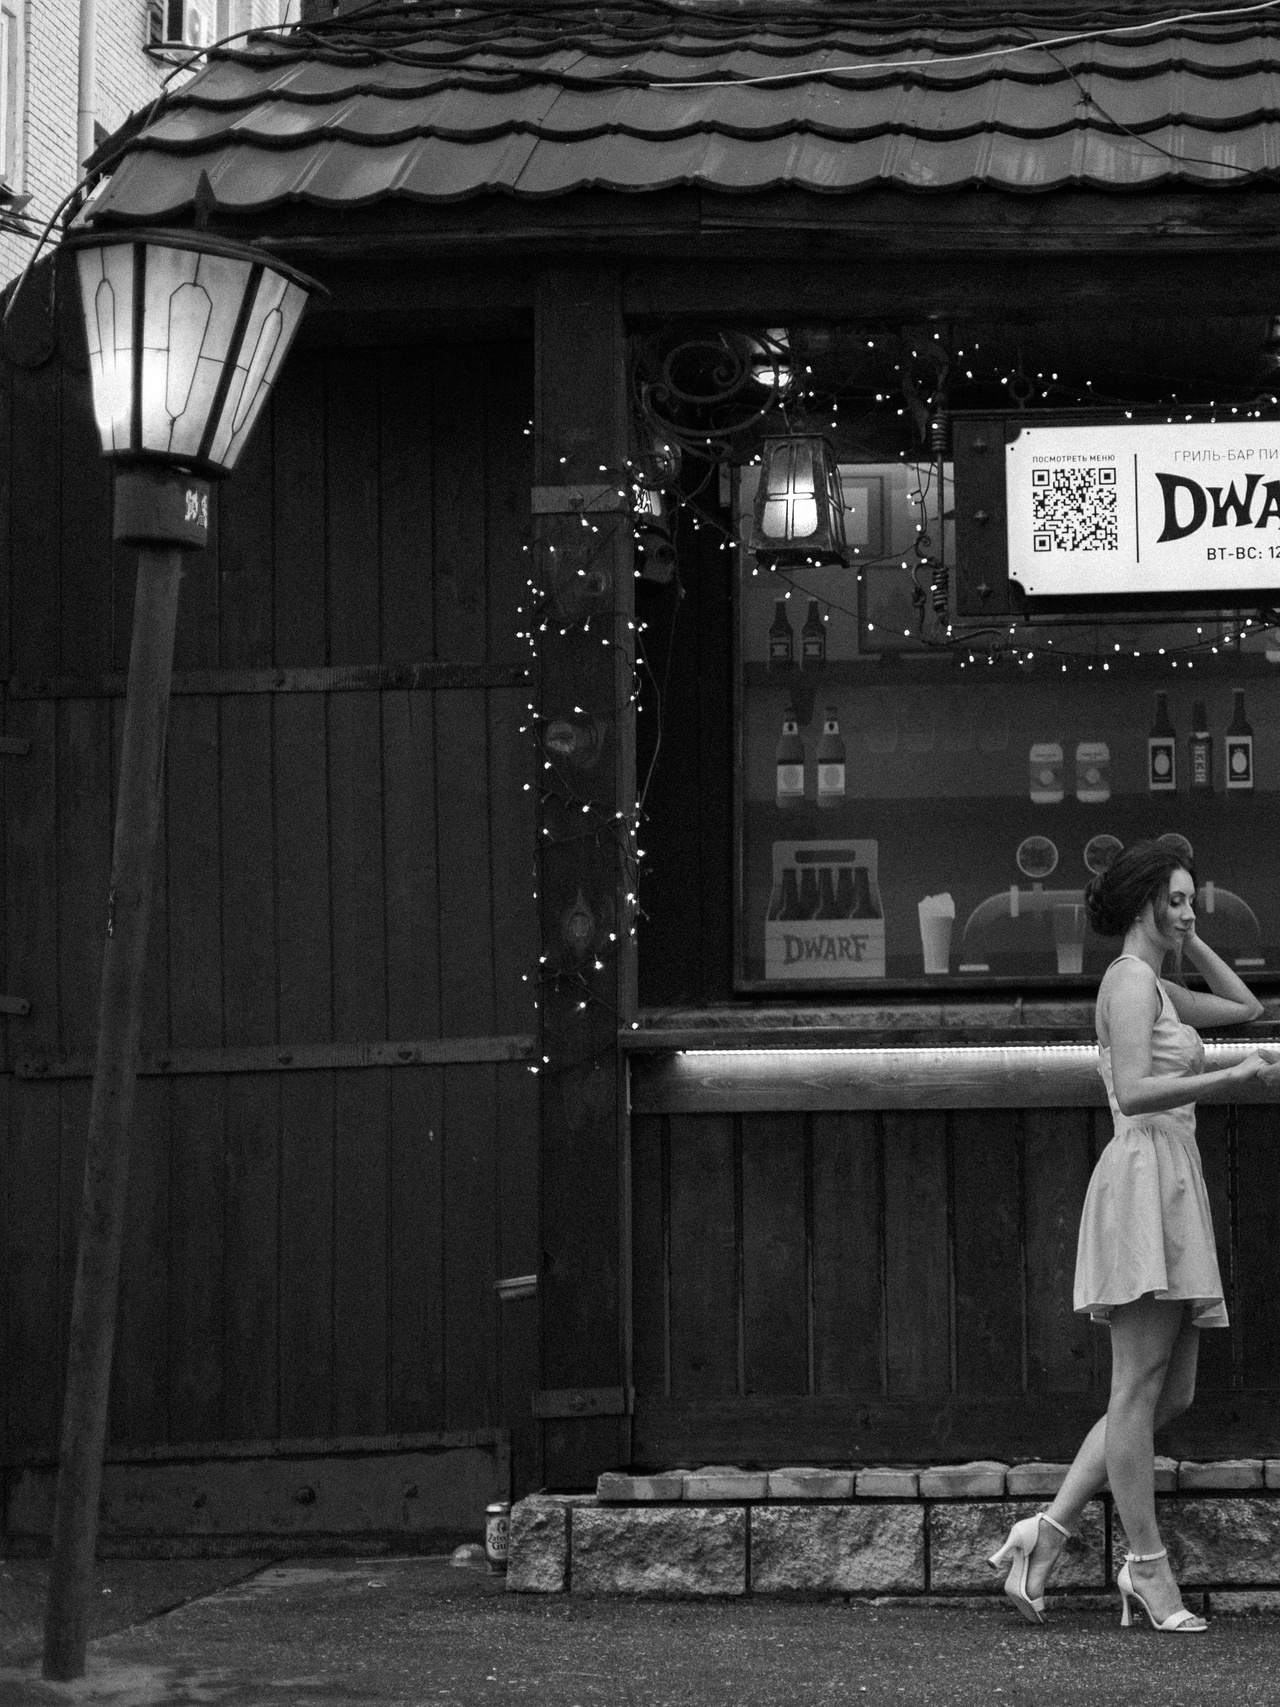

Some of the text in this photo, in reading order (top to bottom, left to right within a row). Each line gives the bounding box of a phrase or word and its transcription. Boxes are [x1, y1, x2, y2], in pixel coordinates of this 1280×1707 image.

[1032, 453, 1116, 463] ПОСМОТРЕТЬ МЕНЮ
[1174, 449, 1255, 462] ГРИЛЬ-БАР
[1206, 547, 1263, 561] ВТ-ВС:
[1194, 745, 1206, 782] BEER
[783, 934, 869, 965] DWARF
